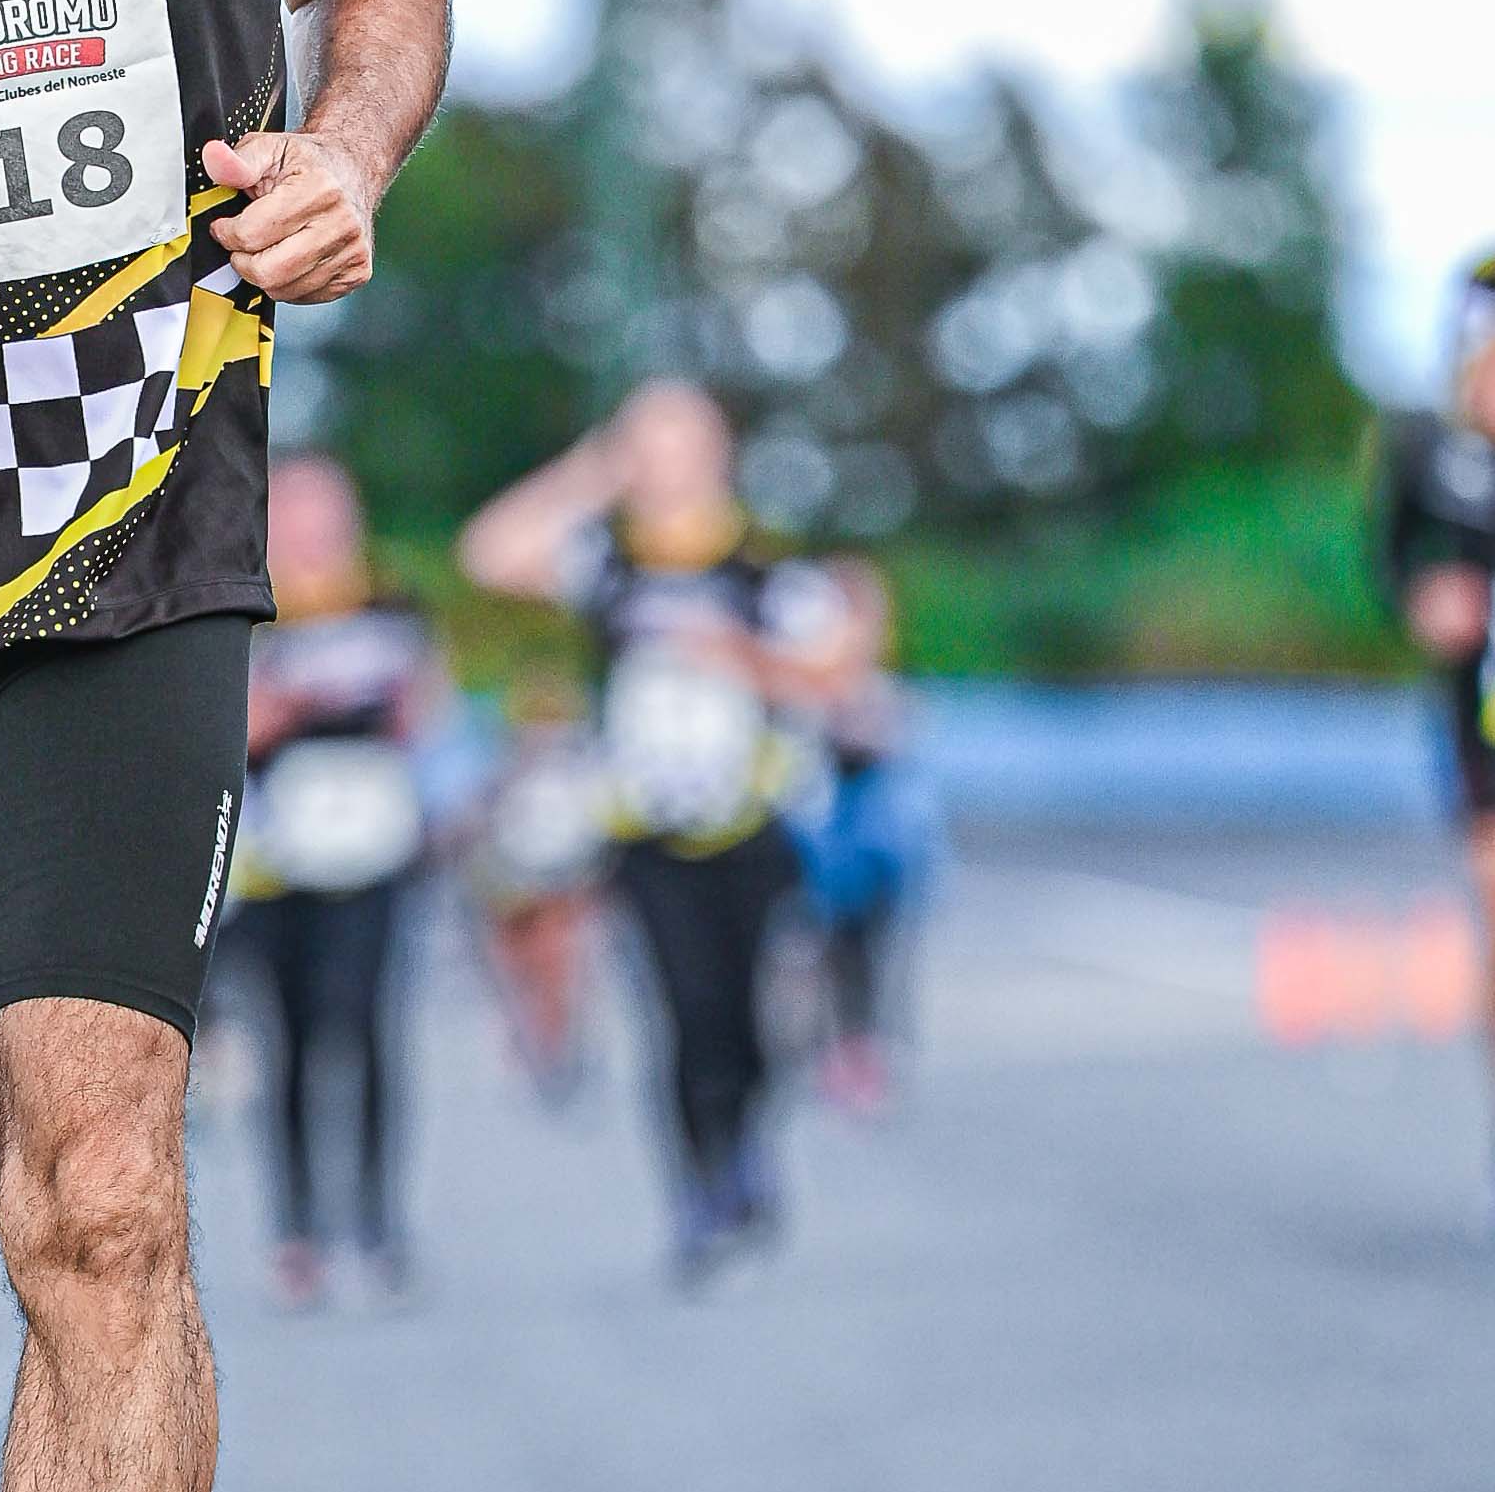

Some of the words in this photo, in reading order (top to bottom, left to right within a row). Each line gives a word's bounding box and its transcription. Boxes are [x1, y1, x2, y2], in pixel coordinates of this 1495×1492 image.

[25, 43, 81, 70] RACE
[45, 78, 65, 93] del
[67, 68, 126, 89] Noroeste
